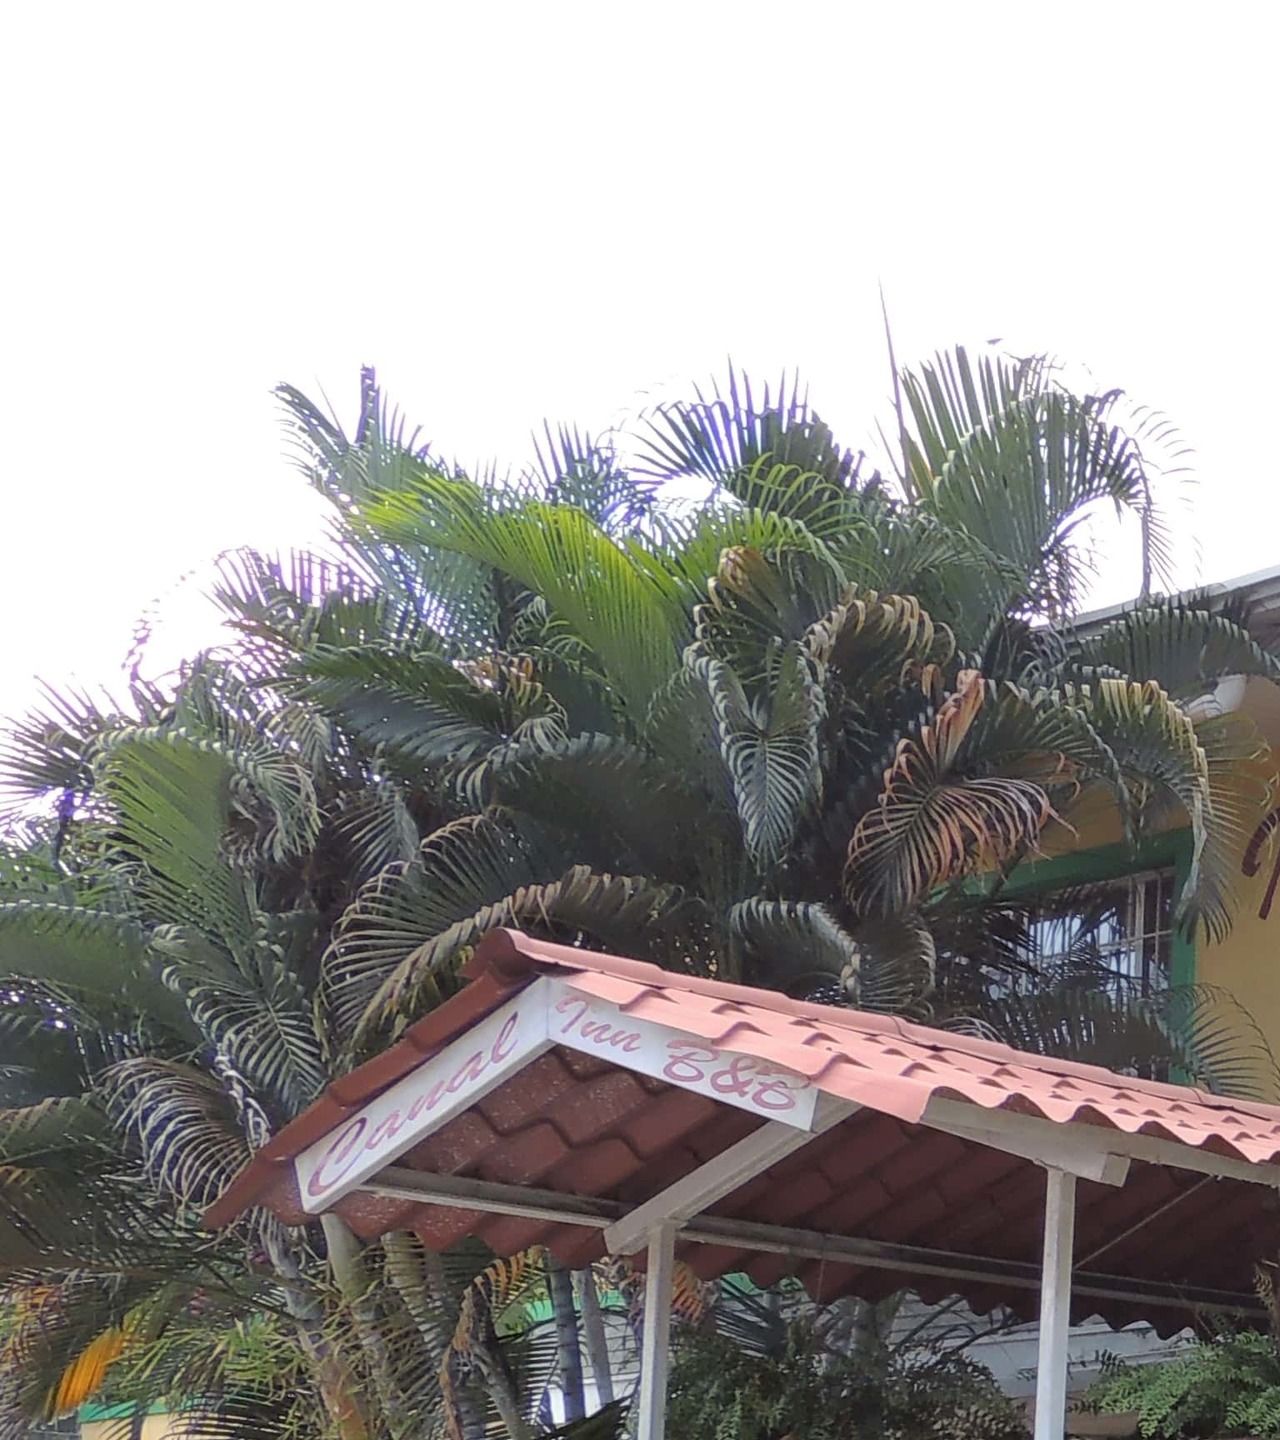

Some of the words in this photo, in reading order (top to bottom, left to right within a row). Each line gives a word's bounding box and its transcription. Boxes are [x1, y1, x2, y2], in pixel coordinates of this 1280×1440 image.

[307, 1011, 518, 1196] Canal
[555, 995, 641, 1052] Inn
[662, 1039, 811, 1110] B&B
